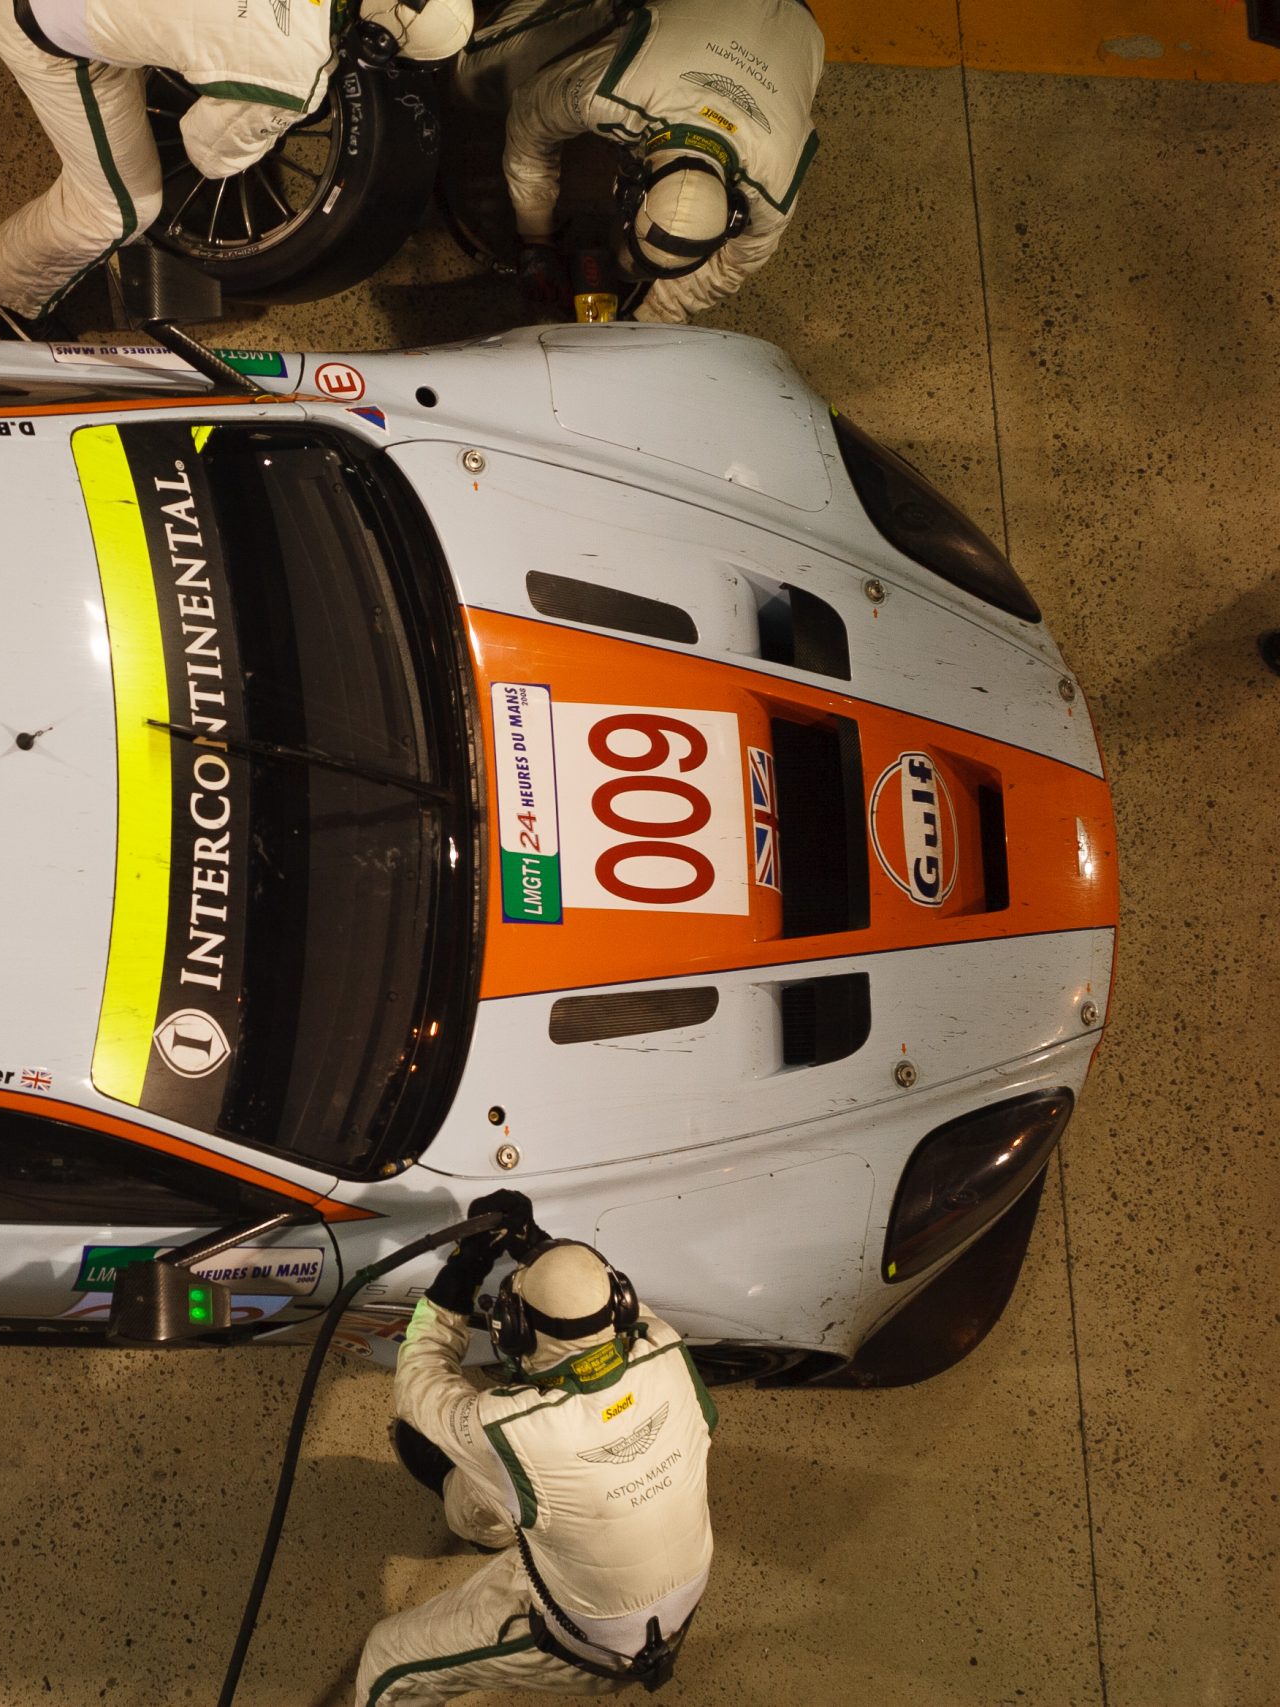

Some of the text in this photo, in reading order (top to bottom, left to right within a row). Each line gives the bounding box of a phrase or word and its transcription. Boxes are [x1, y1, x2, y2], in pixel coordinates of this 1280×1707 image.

[705, 42, 779, 95] ASTON MARTIN
[729, 40, 769, 72] RACING
[702, 107, 735, 132] Sabelt
[55, 346, 95, 356] MANS
[100, 346, 118, 355] DU
[504, 687, 541, 853] 24 HEURES DU MANS
[588, 713, 715, 905] 009
[909, 758, 940, 898] Gulf
[522, 856, 543, 915] LMGT1
[196, 1262, 319, 1281] HEURES DU MANS
[605, 1394, 633, 1420] Sabelt
[606, 1449, 682, 1501] ASTON MARTIN
[631, 1476, 673, 1508] RACING
